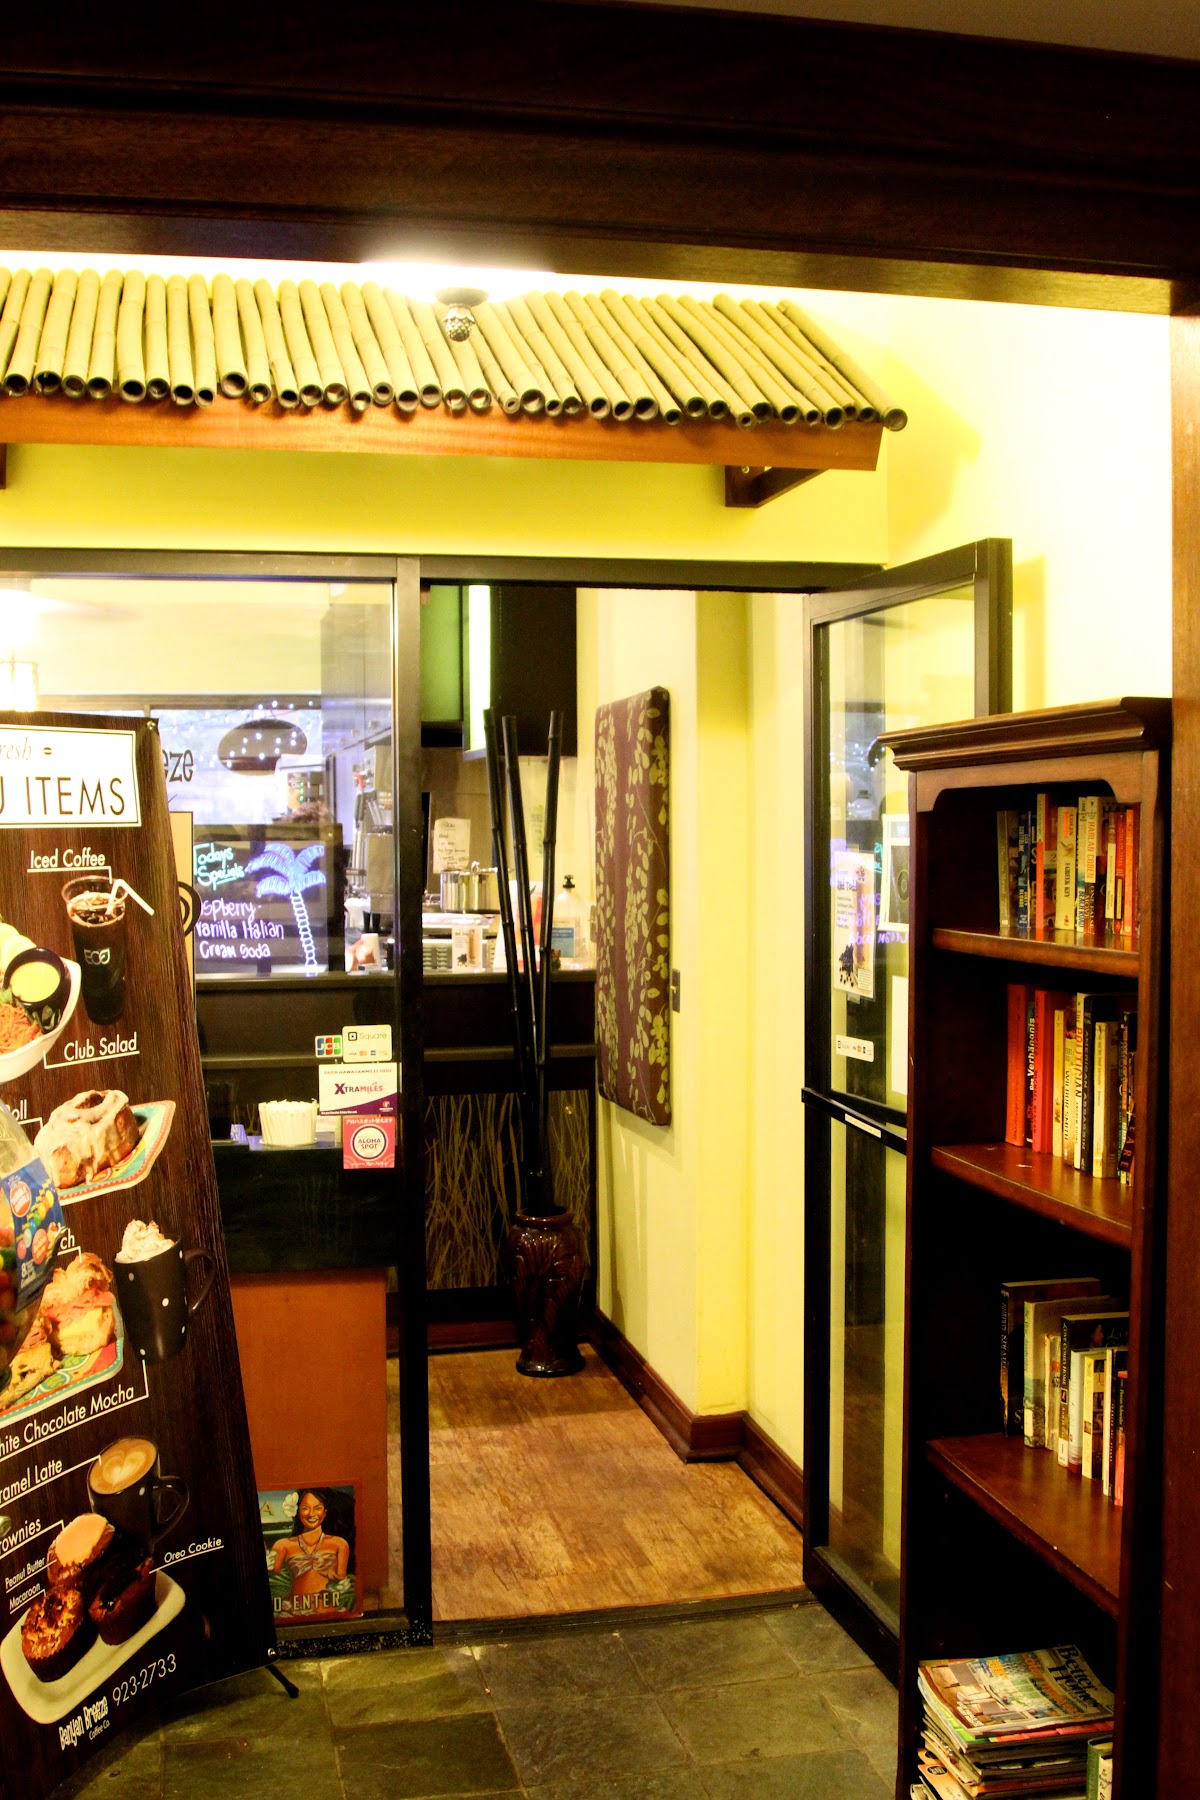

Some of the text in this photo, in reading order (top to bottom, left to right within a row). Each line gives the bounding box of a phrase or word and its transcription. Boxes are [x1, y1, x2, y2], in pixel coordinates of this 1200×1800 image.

[26, 776, 125, 816] ITEMS
[31, 847, 106, 869] Iced Coffee
[1086, 821, 1095, 879] HARLAN COBEN
[197, 863, 245, 891] Specials
[64, 1031, 137, 1061] Club Salad
[359, 1032, 387, 1040] Square
[1075, 1027, 1083, 1098] POLITICIAN
[23, 1406, 86, 1444] Chocolate
[90, 1384, 134, 1415] Mocha
[34, 1458, 63, 1484] Latte
[164, 1537, 222, 1563] Oreo Cookie
[5, 1557, 45, 1590] Peanut Butter
[9, 1583, 41, 1611] Macaroon
[293, 1591, 340, 1610] ENTER
[1058, 1647, 1098, 1691] Better
[59, 1653, 177, 1751] Banyan Breeze 923-2733
